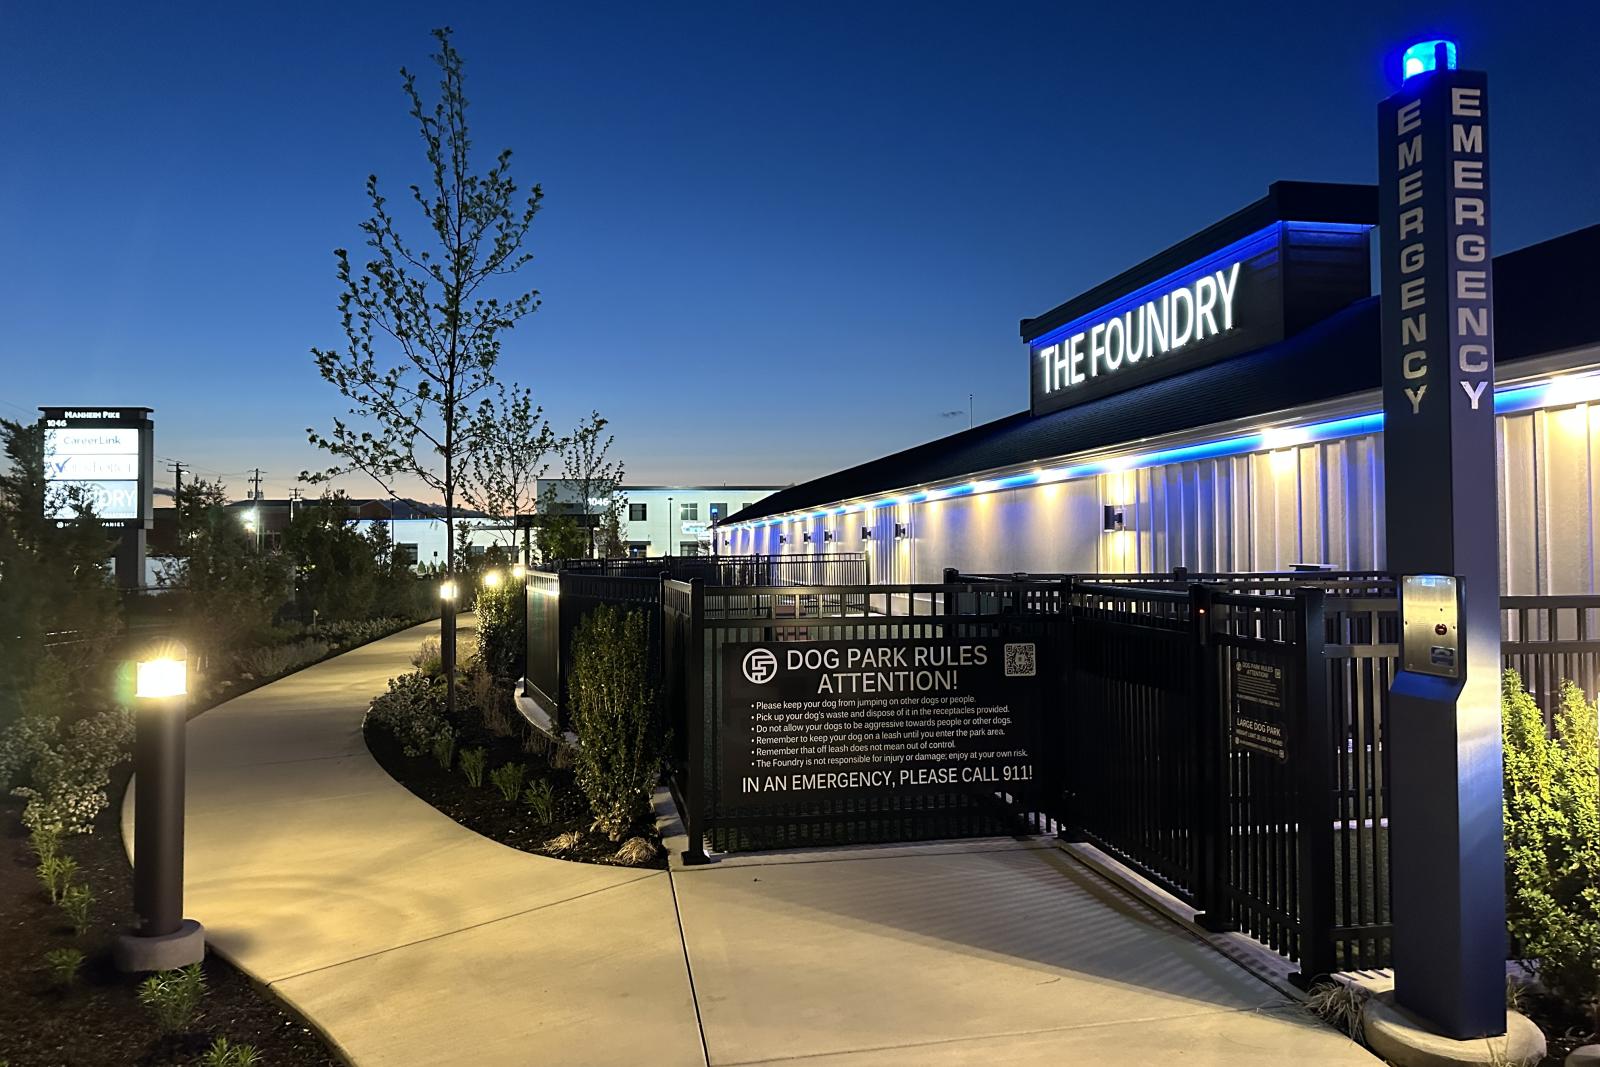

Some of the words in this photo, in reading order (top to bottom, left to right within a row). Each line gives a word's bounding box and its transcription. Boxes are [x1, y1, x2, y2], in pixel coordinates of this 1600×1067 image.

[1397, 99, 1428, 414] EMERGENCY
[1451, 87, 1489, 410] EMERGENCY
[1041, 332, 1086, 394] THE
[1091, 262, 1240, 377] FOUNDRY
[47, 419, 67, 427] 1046
[787, 649, 840, 670] DOG
[847, 647, 907, 668] PARK
[914, 645, 988, 667] RULES
[817, 670, 957, 694] ATTENTION!
[756, 701, 781, 710] Please
[783, 700, 802, 711] keep
[803, 700, 820, 710] your
[821, 699, 837, 709] dog
[838, 699, 855, 707] from
[856, 697, 888, 708] jumping
[900, 697, 919, 705] other
[920, 696, 939, 706] dogs
[949, 695, 976, 705] people.
[756, 713, 772, 721] Pick
[774, 714, 784, 722] up
[785, 713, 803, 722] your
[804, 711, 824, 721] dog's
[826, 710, 849, 719] waste
[850, 709, 865, 717] and
[866, 708, 895, 719] dispose
[896, 707, 904, 716] of
[905, 707, 910, 716] it
[911, 707, 919, 715] in
[919, 706, 932, 715] the
[933, 706, 975, 716] receptacles
[976, 705, 1010, 715] provided.
[756, 725, 767, 733] Do
[769, 724, 781, 732] not
[783, 723, 803, 731] allow
[805, 723, 822, 733] your
[823, 722, 843, 731] dogs
[844, 722, 852, 730] to
[853, 721, 862, 729] be
[864, 720, 904, 731] aggressive
[905, 718, 935, 727] towards
[936, 718, 962, 727] people
[972, 717, 991, 725] other
[992, 716, 1012, 726] dogs.
[1237, 718, 1253, 729] LARGE
[1254, 722, 1266, 733] DOG
[1266, 725, 1281, 737] PARK
[756, 735, 798, 744] Remember
[800, 735, 808, 743] to
[809, 734, 828, 743] keep
[829, 734, 847, 743] your
[847, 732, 863, 742] dog
[881, 731, 901, 739] leash
[903, 730, 919, 739] until
[920, 731, 934, 740] you
[956, 728, 968, 737] the
[969, 728, 986, 738] park
[987, 728, 1005, 736] area.
[756, 746, 798, 756] Remember
[800, 746, 815, 754] that
[816, 745, 827, 753] off
[828, 744, 848, 753] leash
[849, 743, 868, 752] does
[870, 743, 883, 751] not
[883, 742, 905, 750] mean
[906, 742, 919, 750] out
[920, 741, 928, 749] of
[928, 740, 956, 748] control.
[756, 759, 771, 767] The
[772, 758, 804, 767] Foundry
[805, 757, 812, 765] is
[813, 757, 826, 765] not
[827, 755, 870, 765] responsible
[872, 754, 882, 762] for
[883, 754, 904, 763] injury
[948, 752, 968, 761] enjoy
[970, 751, 978, 759] at
[978, 752, 995, 760] your
[1013, 749, 1028, 757] risk.
[742, 777, 759, 792] IN
[764, 775, 787, 791] AN
[792, 770, 895, 790] EMERGENCY,
[900, 768, 957, 785] PLEASE
[962, 766, 999, 782] CALL
[1003, 765, 1033, 781] 911!
